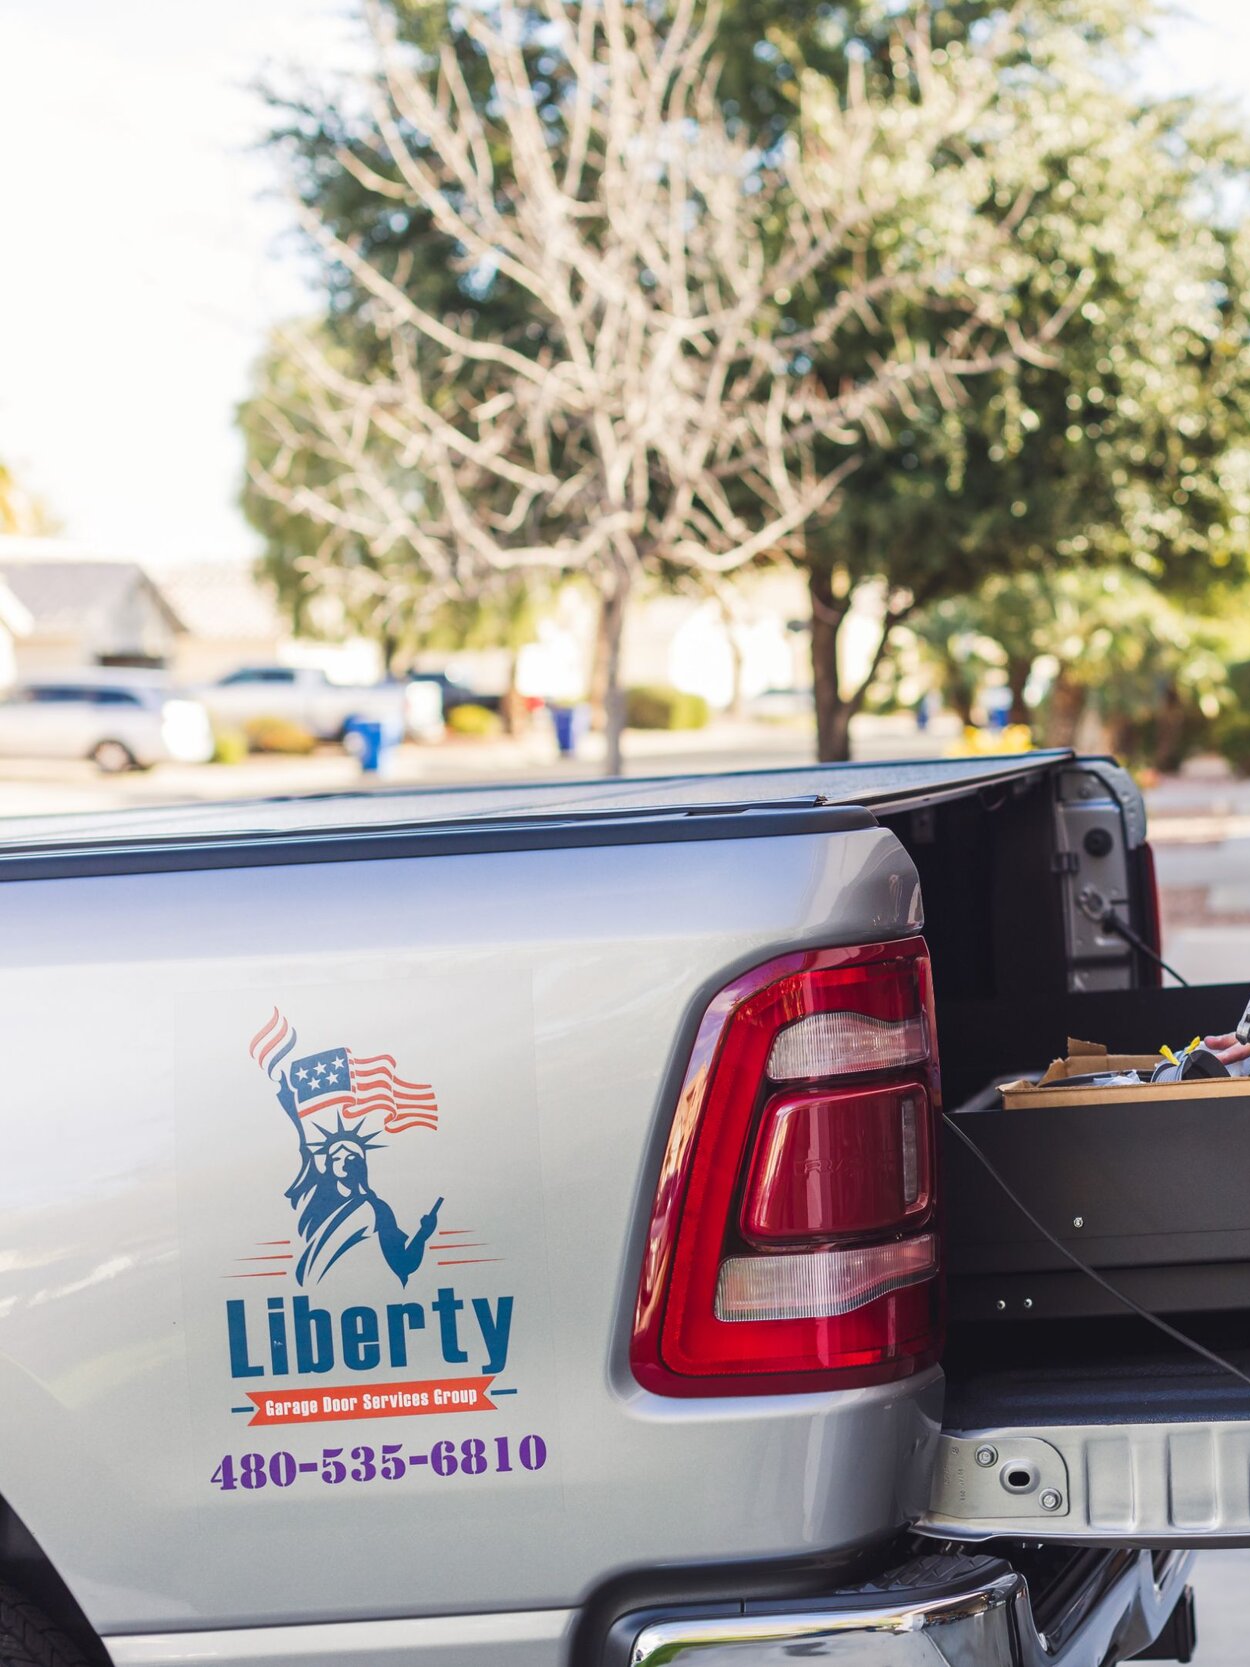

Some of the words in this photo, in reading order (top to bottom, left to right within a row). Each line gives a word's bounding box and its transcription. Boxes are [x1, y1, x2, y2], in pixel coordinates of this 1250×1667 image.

[226, 1288, 514, 1378] Liberty
[265, 1396, 318, 1417] Garage
[323, 1394, 359, 1413] Door
[363, 1390, 430, 1410] Services
[434, 1388, 478, 1407] Group
[210, 1434, 547, 1491] 480-535-6810
